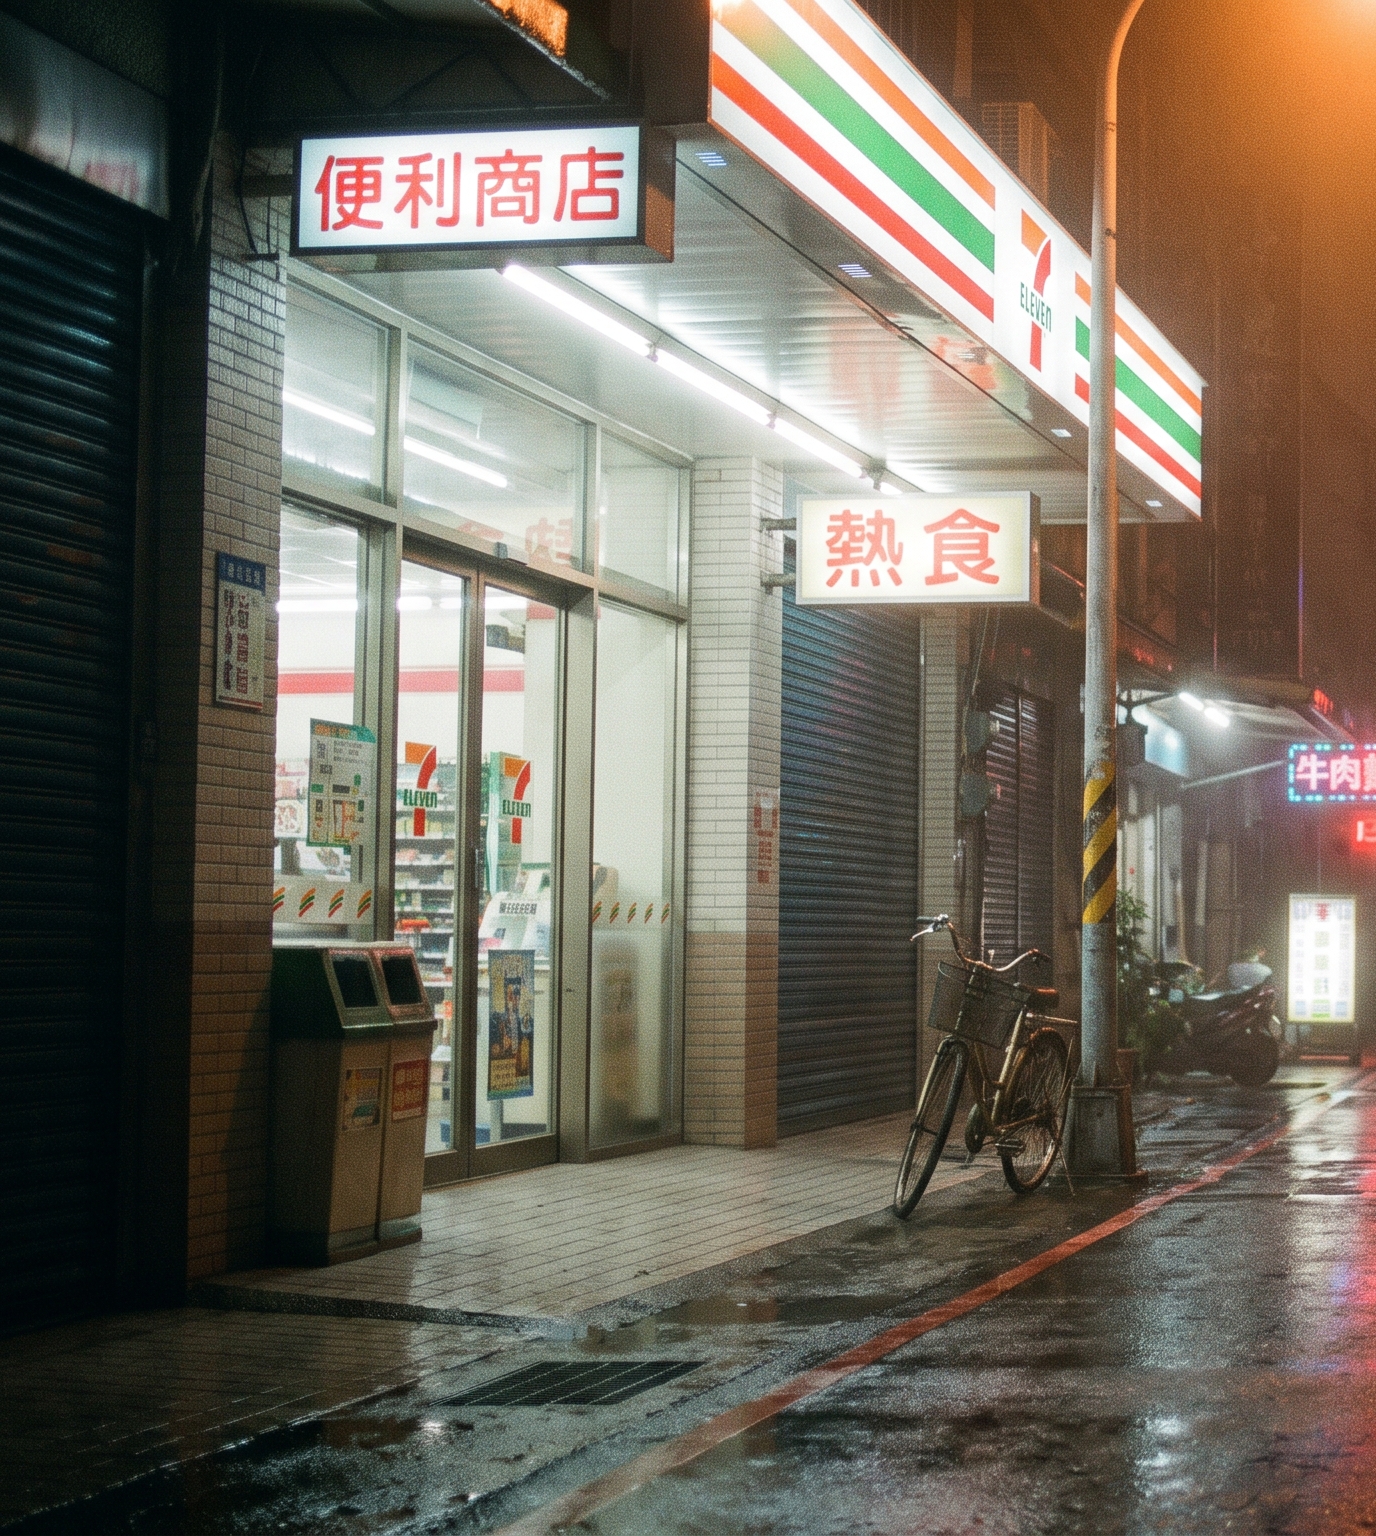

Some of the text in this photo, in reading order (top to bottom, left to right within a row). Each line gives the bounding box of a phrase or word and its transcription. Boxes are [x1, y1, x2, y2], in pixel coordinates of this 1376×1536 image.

[314, 145, 626, 232] 便利商店
[825, 508, 1001, 588] 熱食
